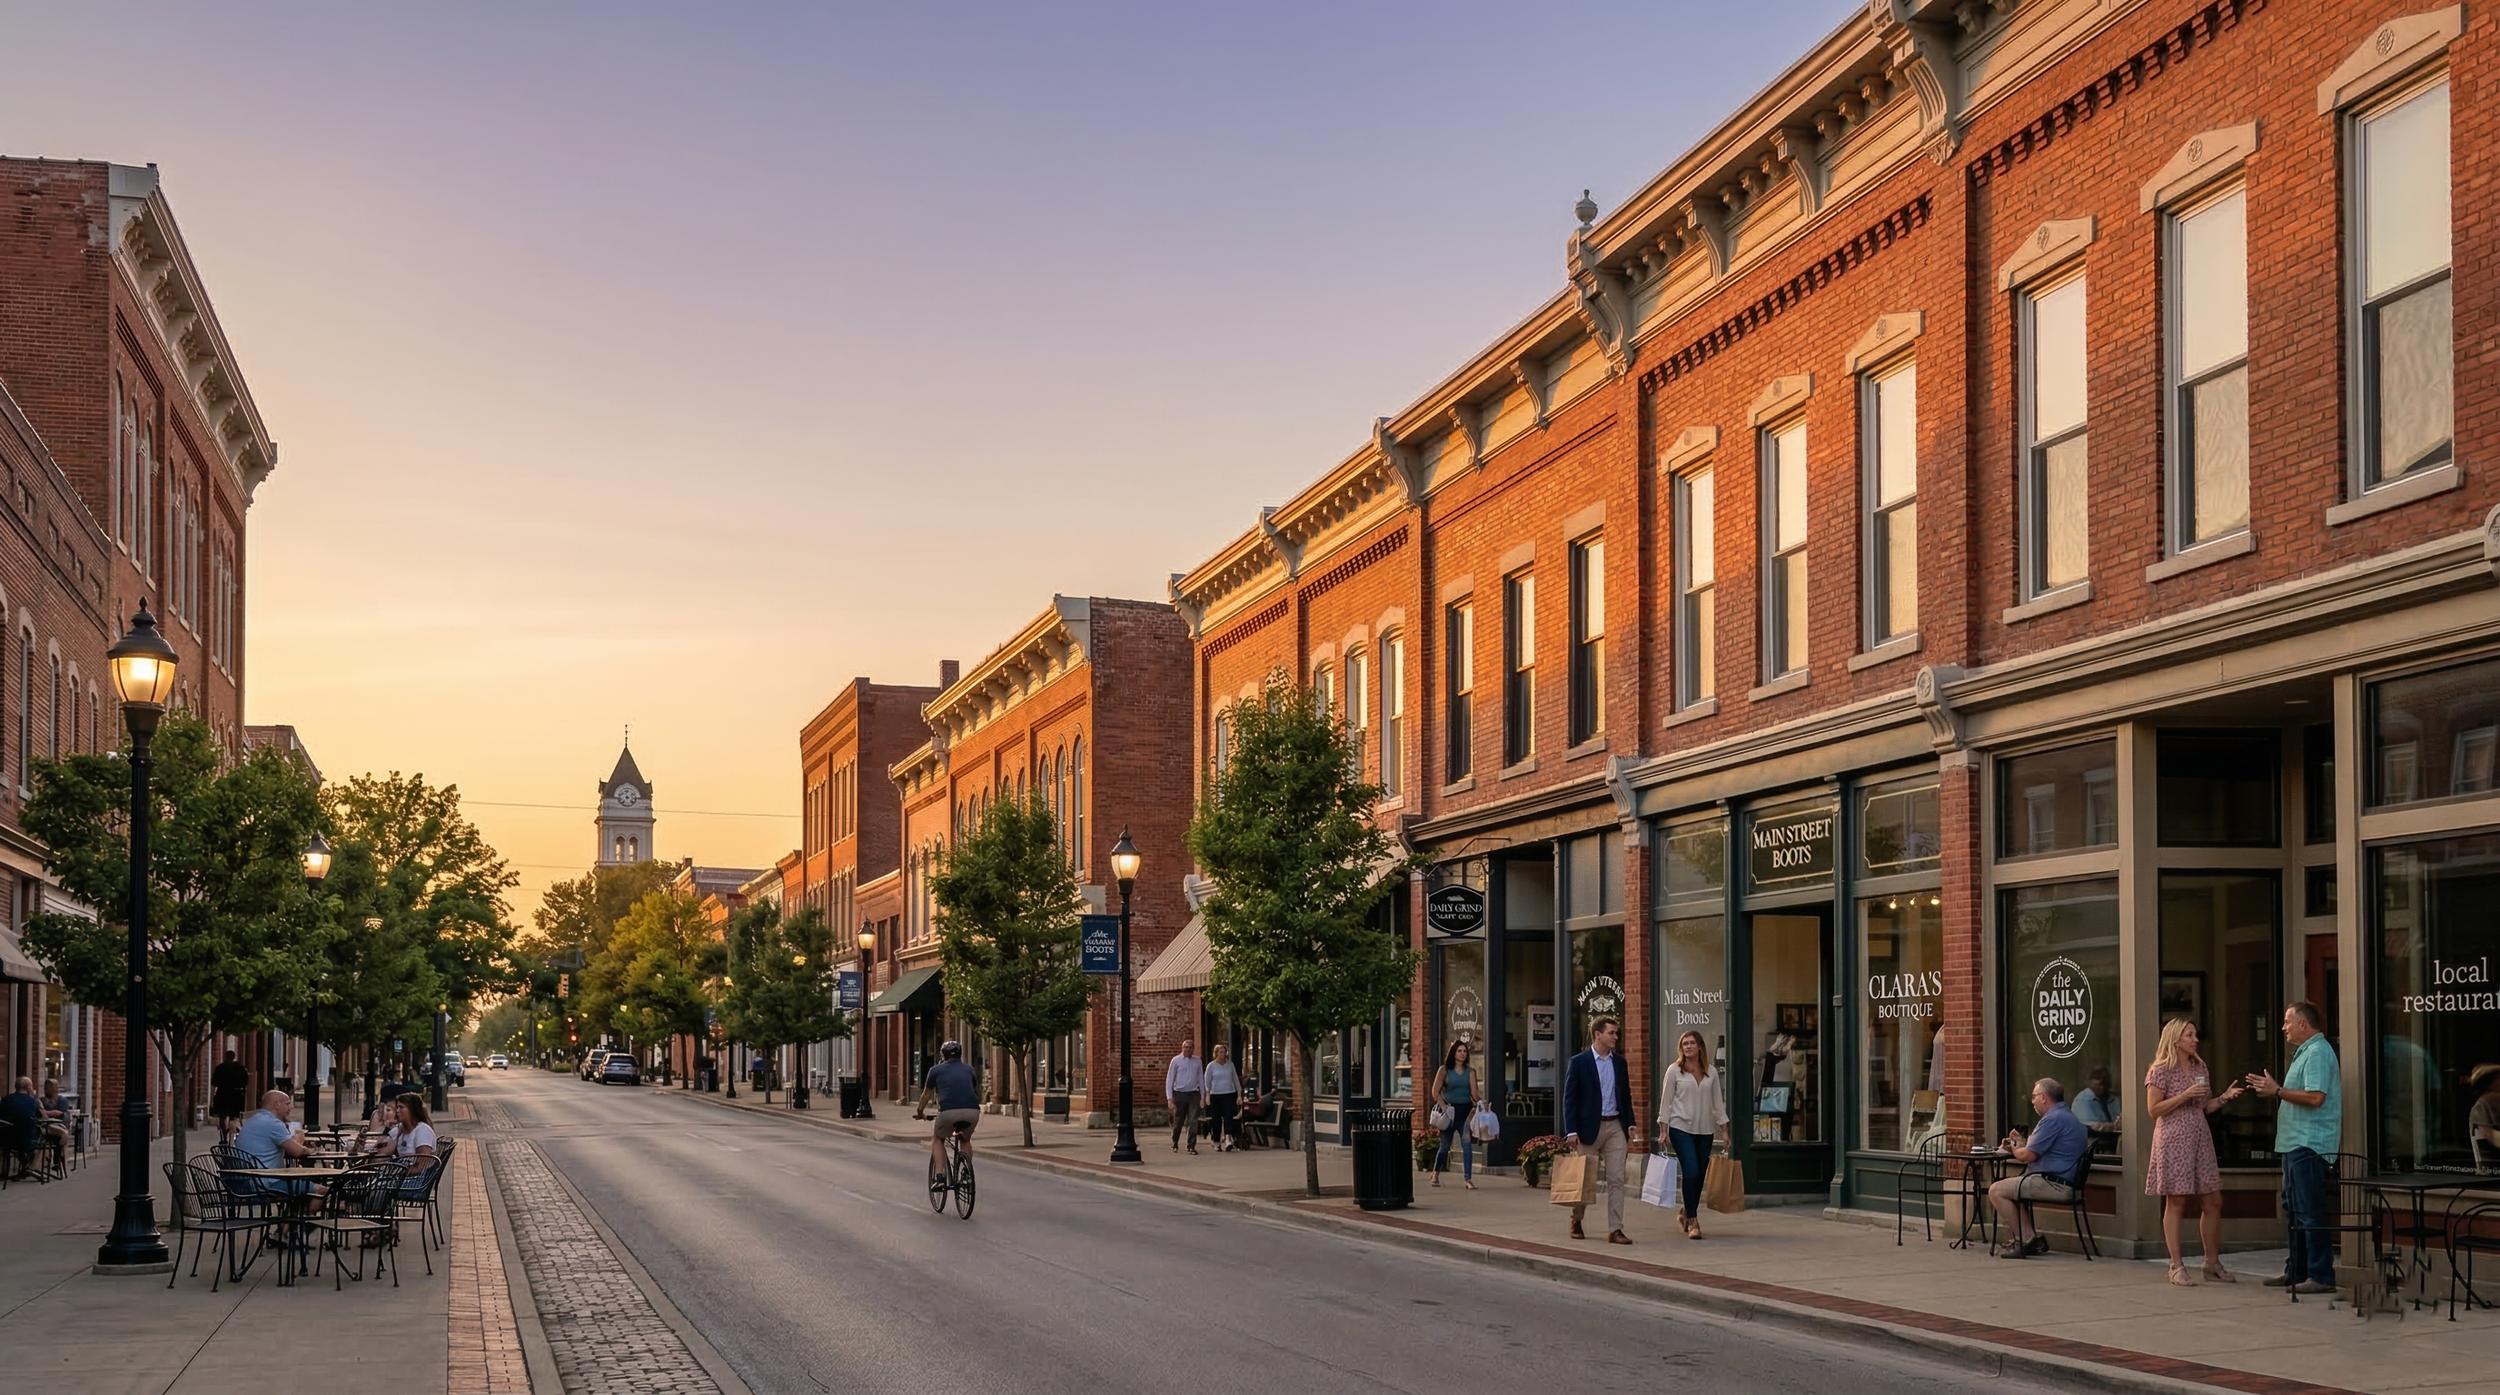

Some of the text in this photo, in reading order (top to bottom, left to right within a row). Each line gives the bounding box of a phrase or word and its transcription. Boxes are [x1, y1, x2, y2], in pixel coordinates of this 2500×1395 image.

[1753, 818, 1832, 850] MAIN STREET
[1772, 844, 1812, 869] BOOTS
[1454, 903, 1483, 913] GRIND
[2051, 970, 2071, 988] the
[2433, 956, 2489, 985] local
[1868, 970, 1942, 1000] CLARA'S
[1664, 987, 1723, 1006] Main Street
[2039, 988, 2085, 1008] DAILY
[1878, 1002, 1934, 1021] BOUTIQUE
[2038, 1008, 2087, 1027] GRIND
